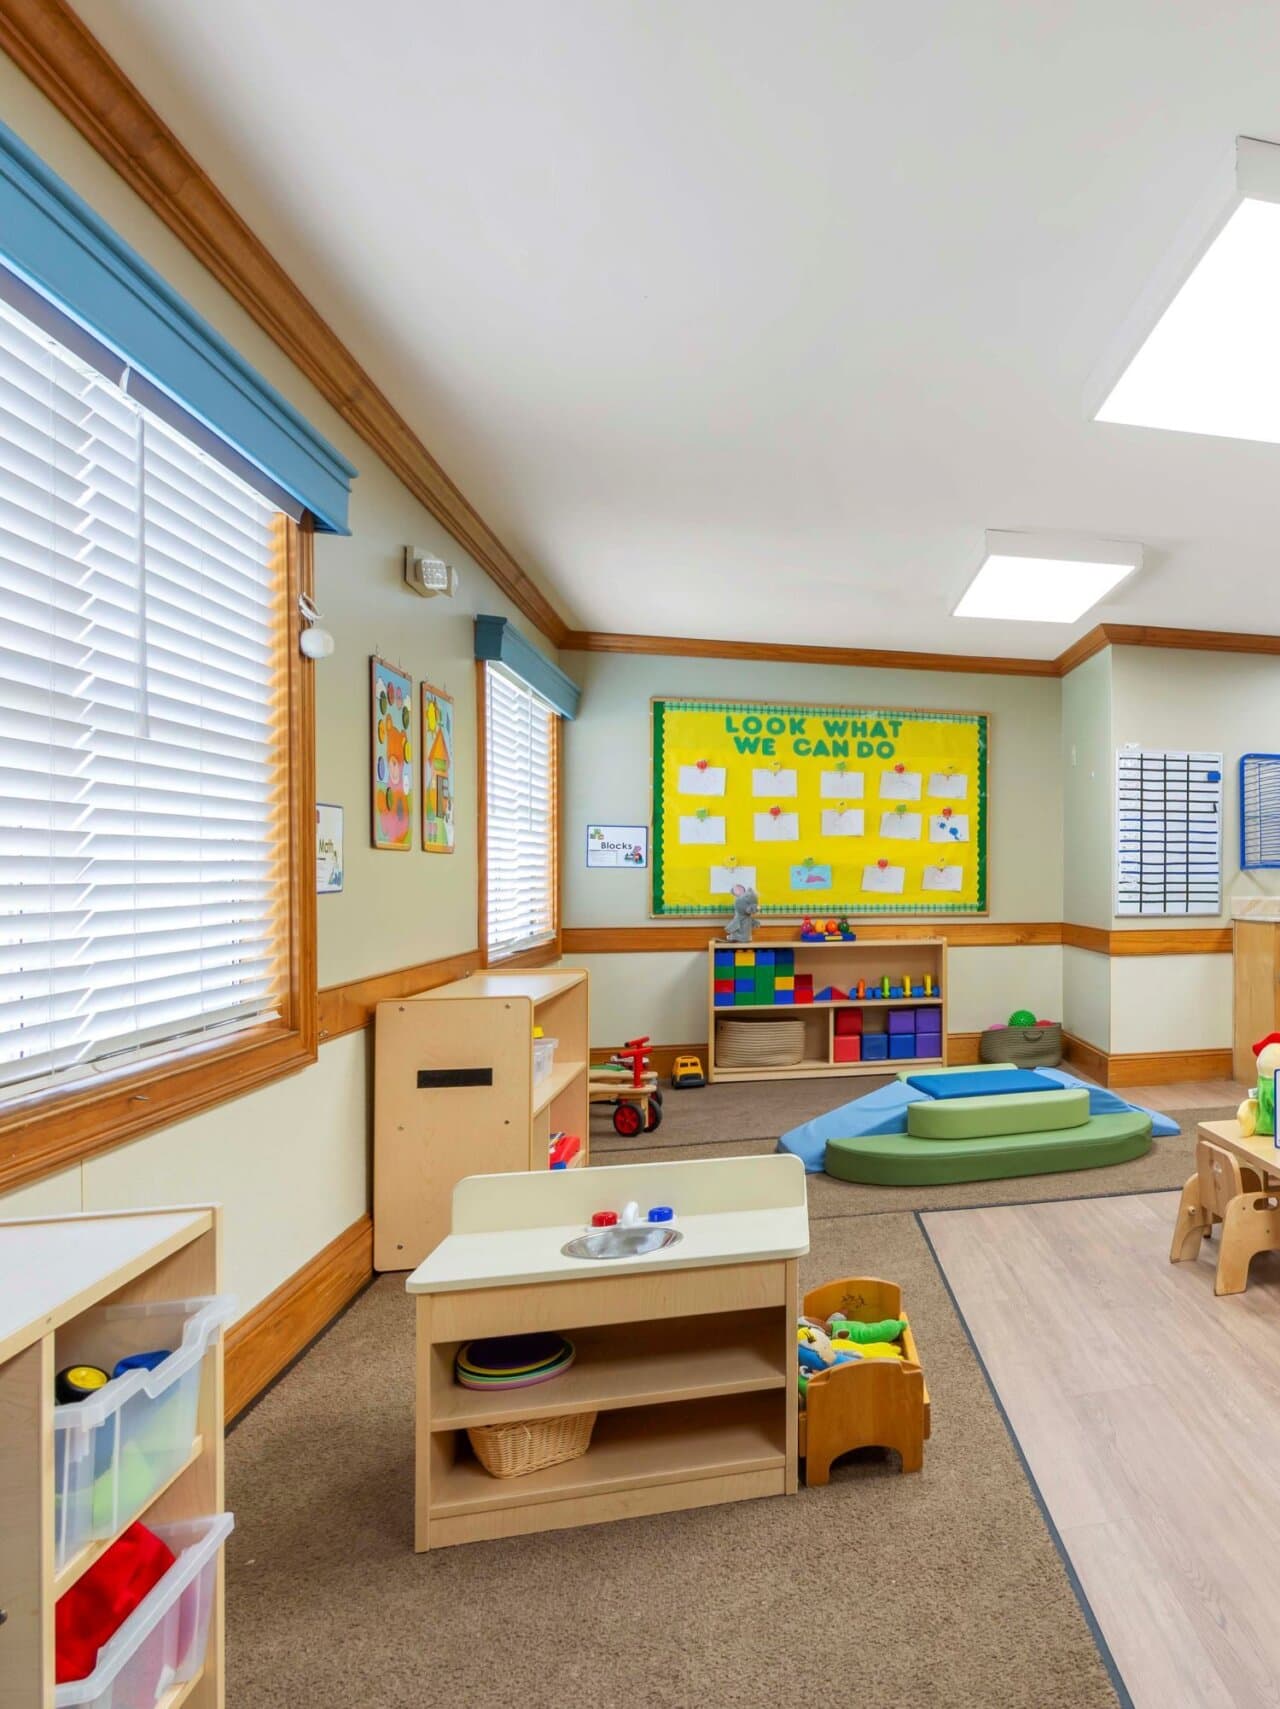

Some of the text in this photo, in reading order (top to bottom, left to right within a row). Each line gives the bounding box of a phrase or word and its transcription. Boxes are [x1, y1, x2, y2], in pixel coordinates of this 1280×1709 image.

[726, 716, 902, 738] LOOK WHAT
[733, 736, 895, 759] WE CAN DO
[601, 842, 632, 850] Blocks
